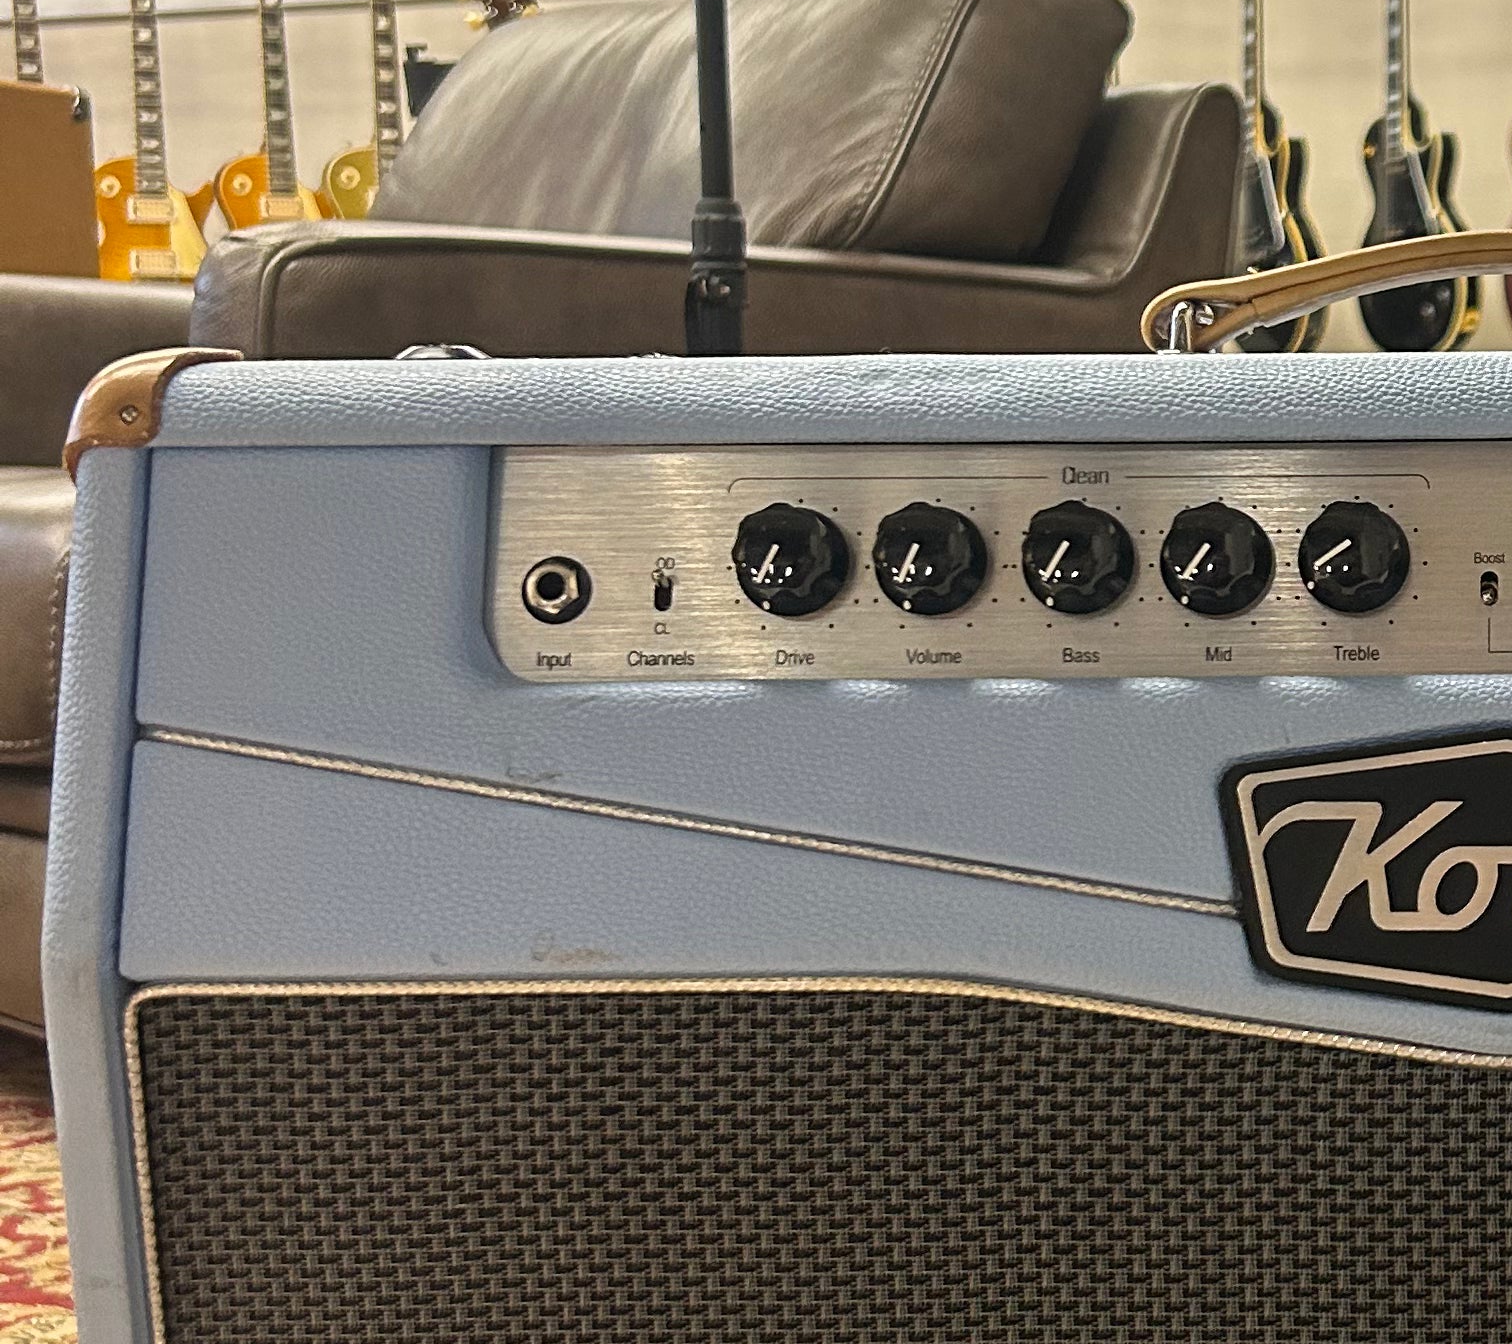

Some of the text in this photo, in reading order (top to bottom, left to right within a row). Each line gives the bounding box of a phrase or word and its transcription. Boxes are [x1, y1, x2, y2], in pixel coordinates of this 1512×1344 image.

[1062, 466, 1109, 485] Clean
[1473, 552, 1505, 565] Boost
[537, 651, 572, 668] Input
[627, 650, 695, 667] Channels
[775, 649, 815, 665] Drive
[907, 648, 962, 665] Volume
[1063, 648, 1101, 664] Bass
[1206, 646, 1233, 663] Mid
[1333, 646, 1380, 662] Treble
